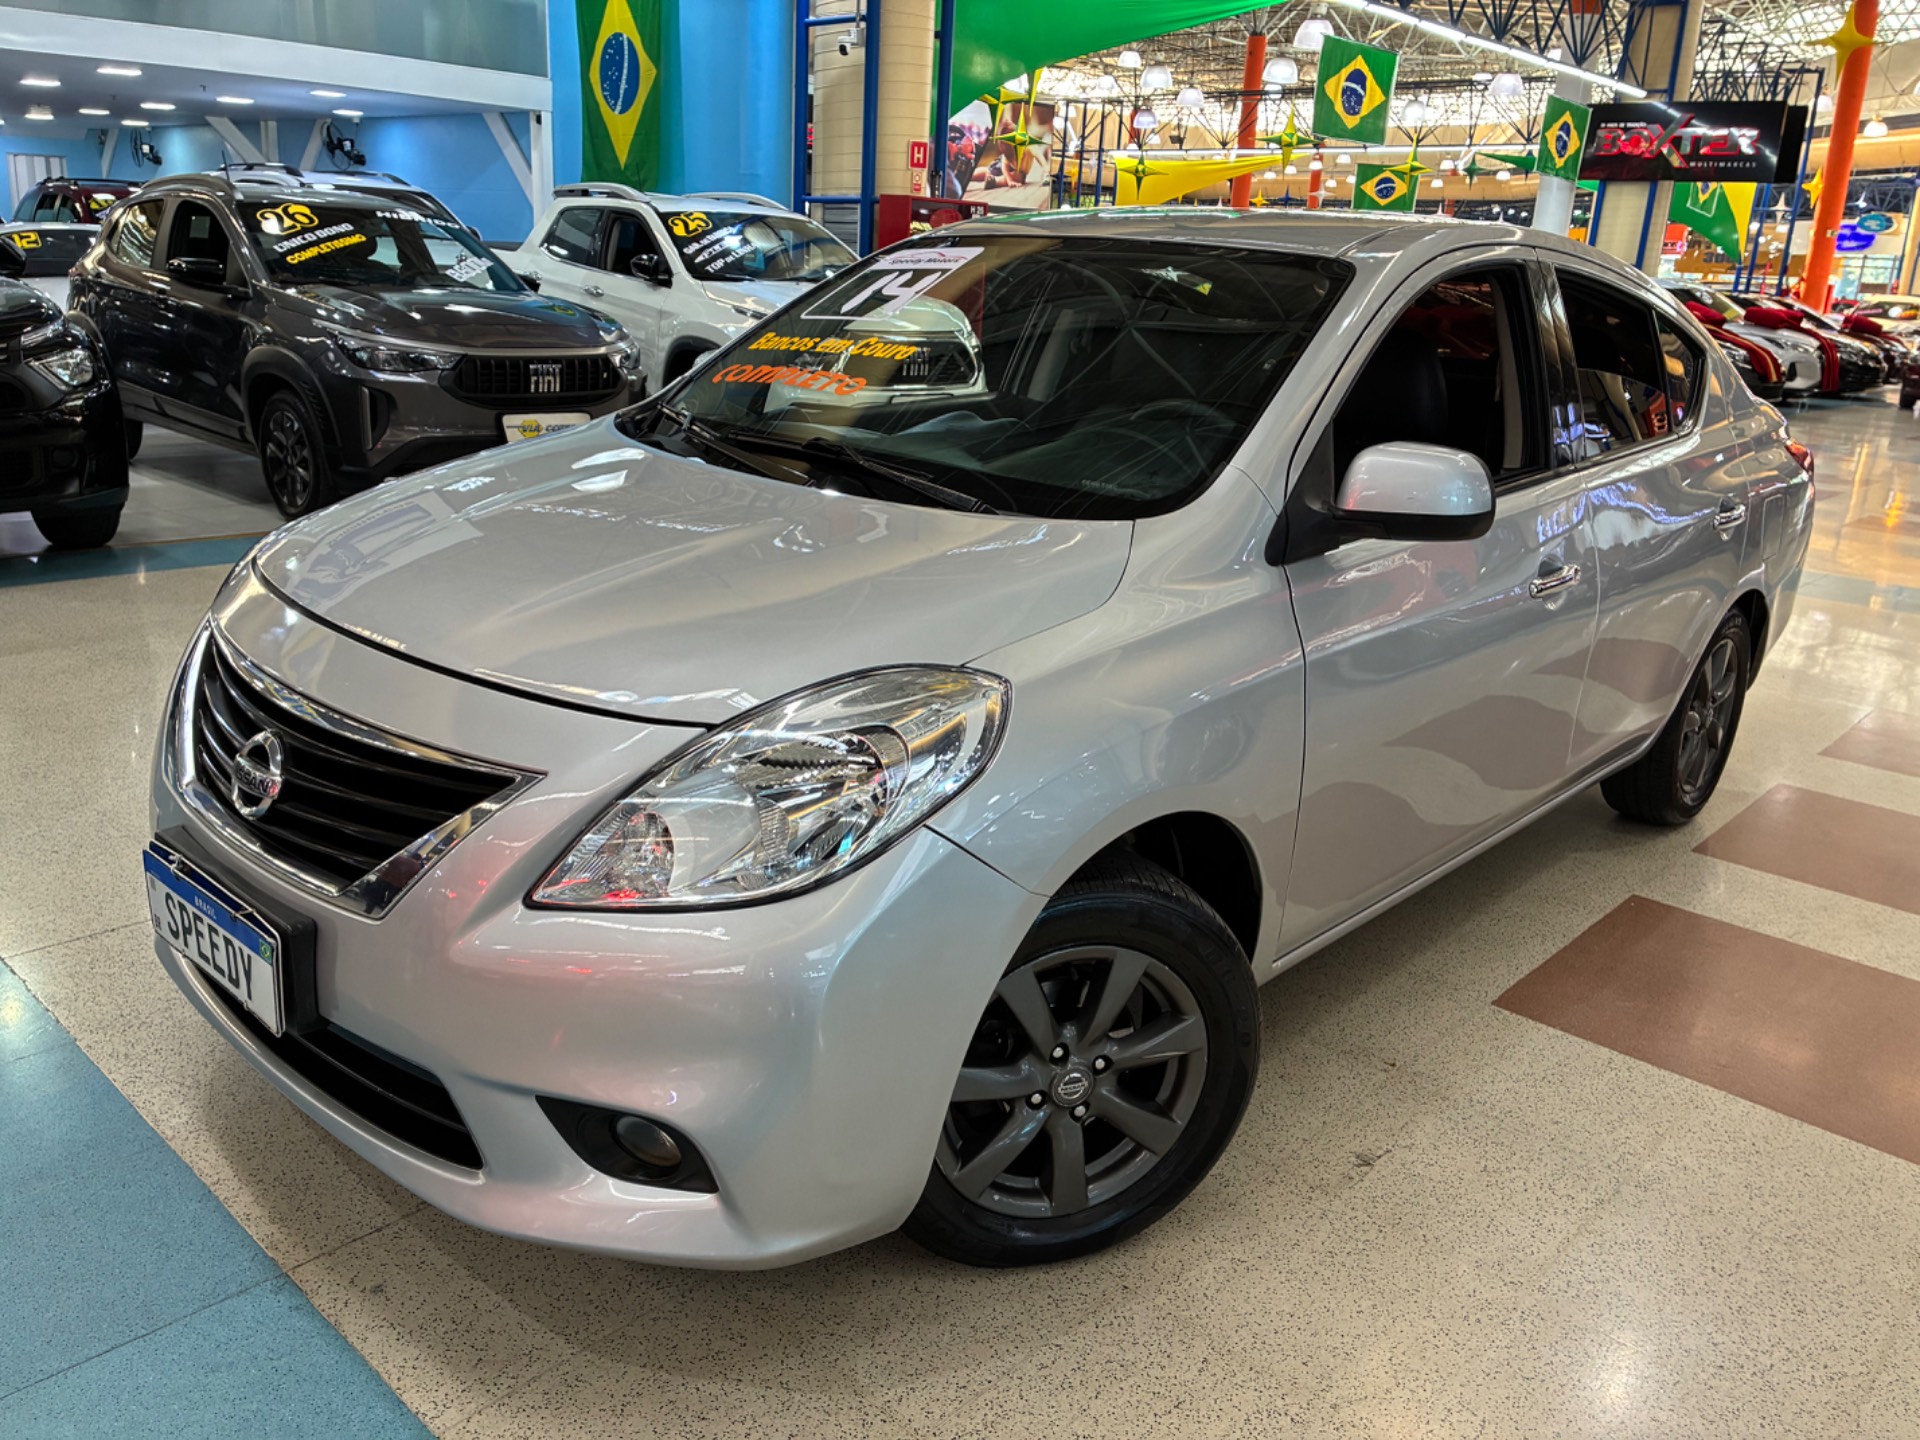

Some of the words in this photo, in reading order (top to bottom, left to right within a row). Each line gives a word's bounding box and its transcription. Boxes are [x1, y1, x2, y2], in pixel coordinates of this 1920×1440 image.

[914, 147, 924, 163] H
[1594, 113, 1761, 168] BOXTER
[272, 232, 318, 253] UNICO
[315, 223, 354, 239] DONO
[668, 211, 713, 237] 25
[705, 258, 725, 273] TOP
[840, 271, 942, 316] 14
[748, 332, 821, 351] Bancos
[815, 337, 854, 353] em
[849, 337, 918, 360] Couro
[528, 364, 562, 393] FIAT
[712, 363, 867, 396] COMPLETO
[194, 895, 217, 919] BRASIL
[165, 892, 253, 1001] SPEEDY
